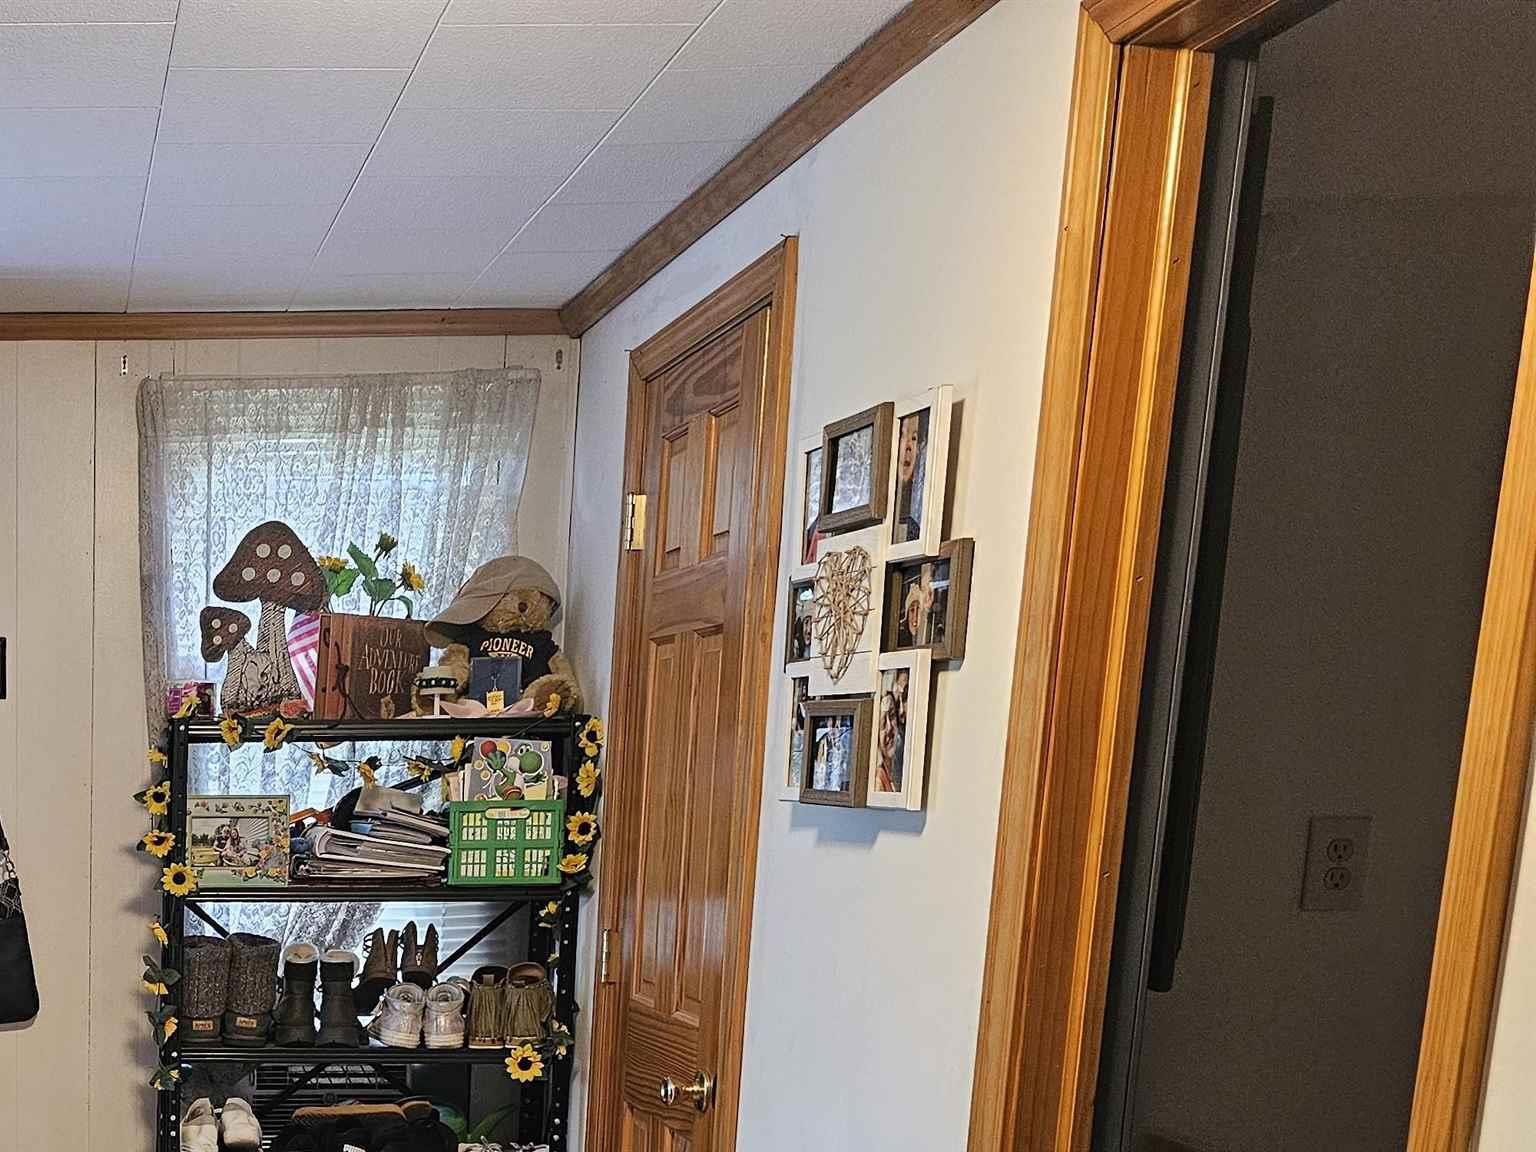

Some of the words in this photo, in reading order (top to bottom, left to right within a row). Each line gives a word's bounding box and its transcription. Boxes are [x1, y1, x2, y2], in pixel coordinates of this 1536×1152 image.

[379, 627, 403, 649] OUR
[479, 637, 535, 661] PIONEER
[357, 642, 422, 674] ADVENTURE
[368, 667, 406, 695] BOOK
